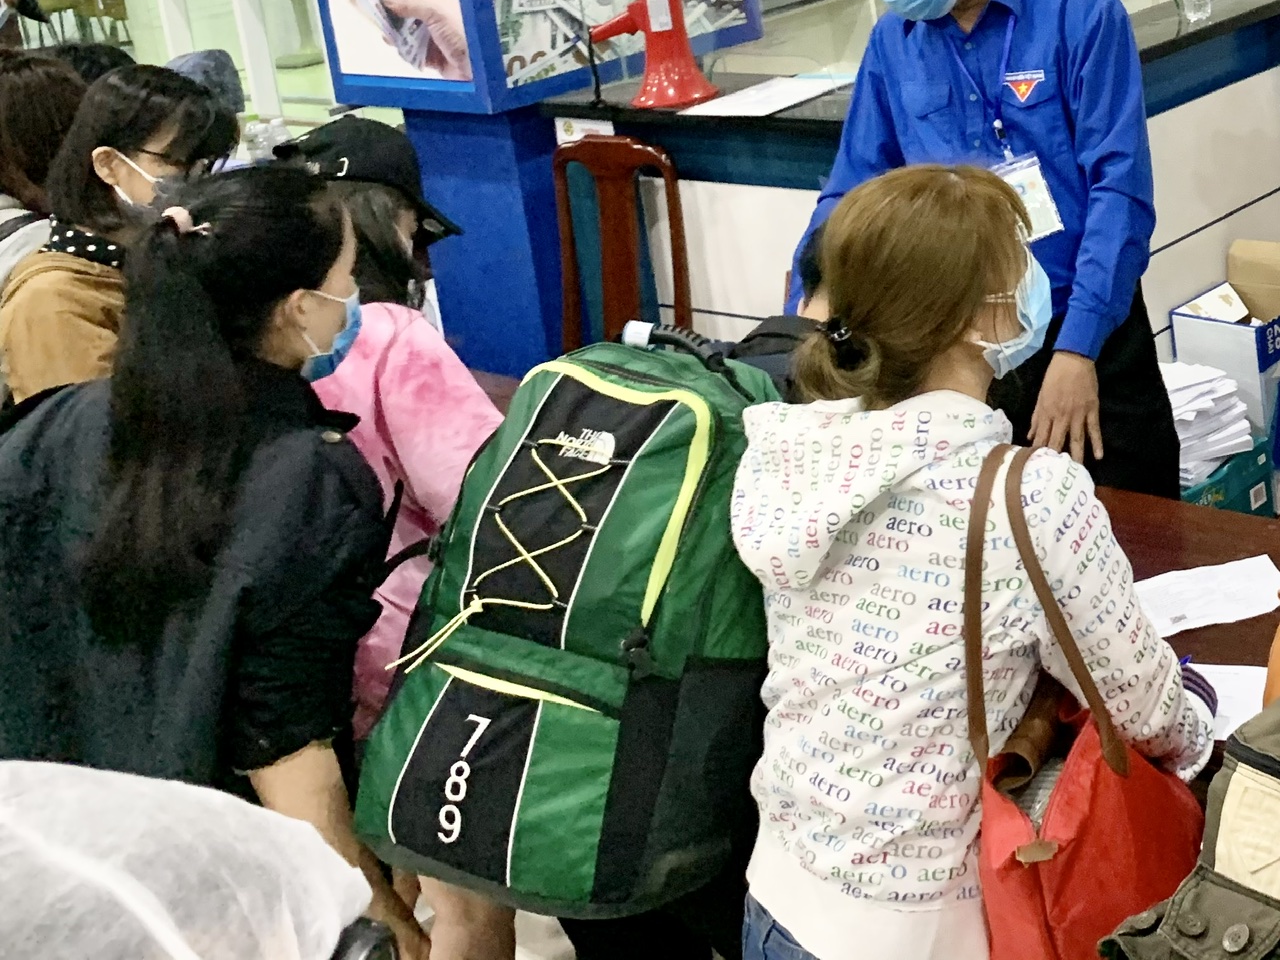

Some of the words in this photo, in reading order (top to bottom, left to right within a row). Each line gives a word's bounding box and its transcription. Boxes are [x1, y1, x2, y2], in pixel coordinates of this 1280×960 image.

[913, 411, 932, 460] aero
[839, 444, 863, 494] aero
[879, 444, 903, 493] aero
[887, 495, 925, 516] aero
[1053, 490, 1088, 542] aero
[886, 516, 933, 537] aero
[1070, 504, 1100, 555] aero
[866, 532, 909, 552] aero
[1077, 524, 1109, 575] aero
[845, 554, 880, 571] aero
[897, 564, 950, 588] aero
[1090, 559, 1121, 609] aero
[809, 590, 850, 606] aero
[870, 582, 916, 606] aero
[804, 604, 834, 624] aero
[855, 596, 901, 621] aero
[806, 625, 843, 645] aero
[851, 617, 899, 644] aero
[795, 639, 829, 660] aero
[853, 640, 898, 665] aero
[831, 652, 868, 676] aero
[851, 684, 900, 711] aero
[837, 699, 884, 731] aero
[844, 724, 897, 751] aero
[900, 722, 954, 738] aero
[818, 730, 863, 759] aero
[809, 771, 850, 802] aero
[928, 792, 970, 809] aero
